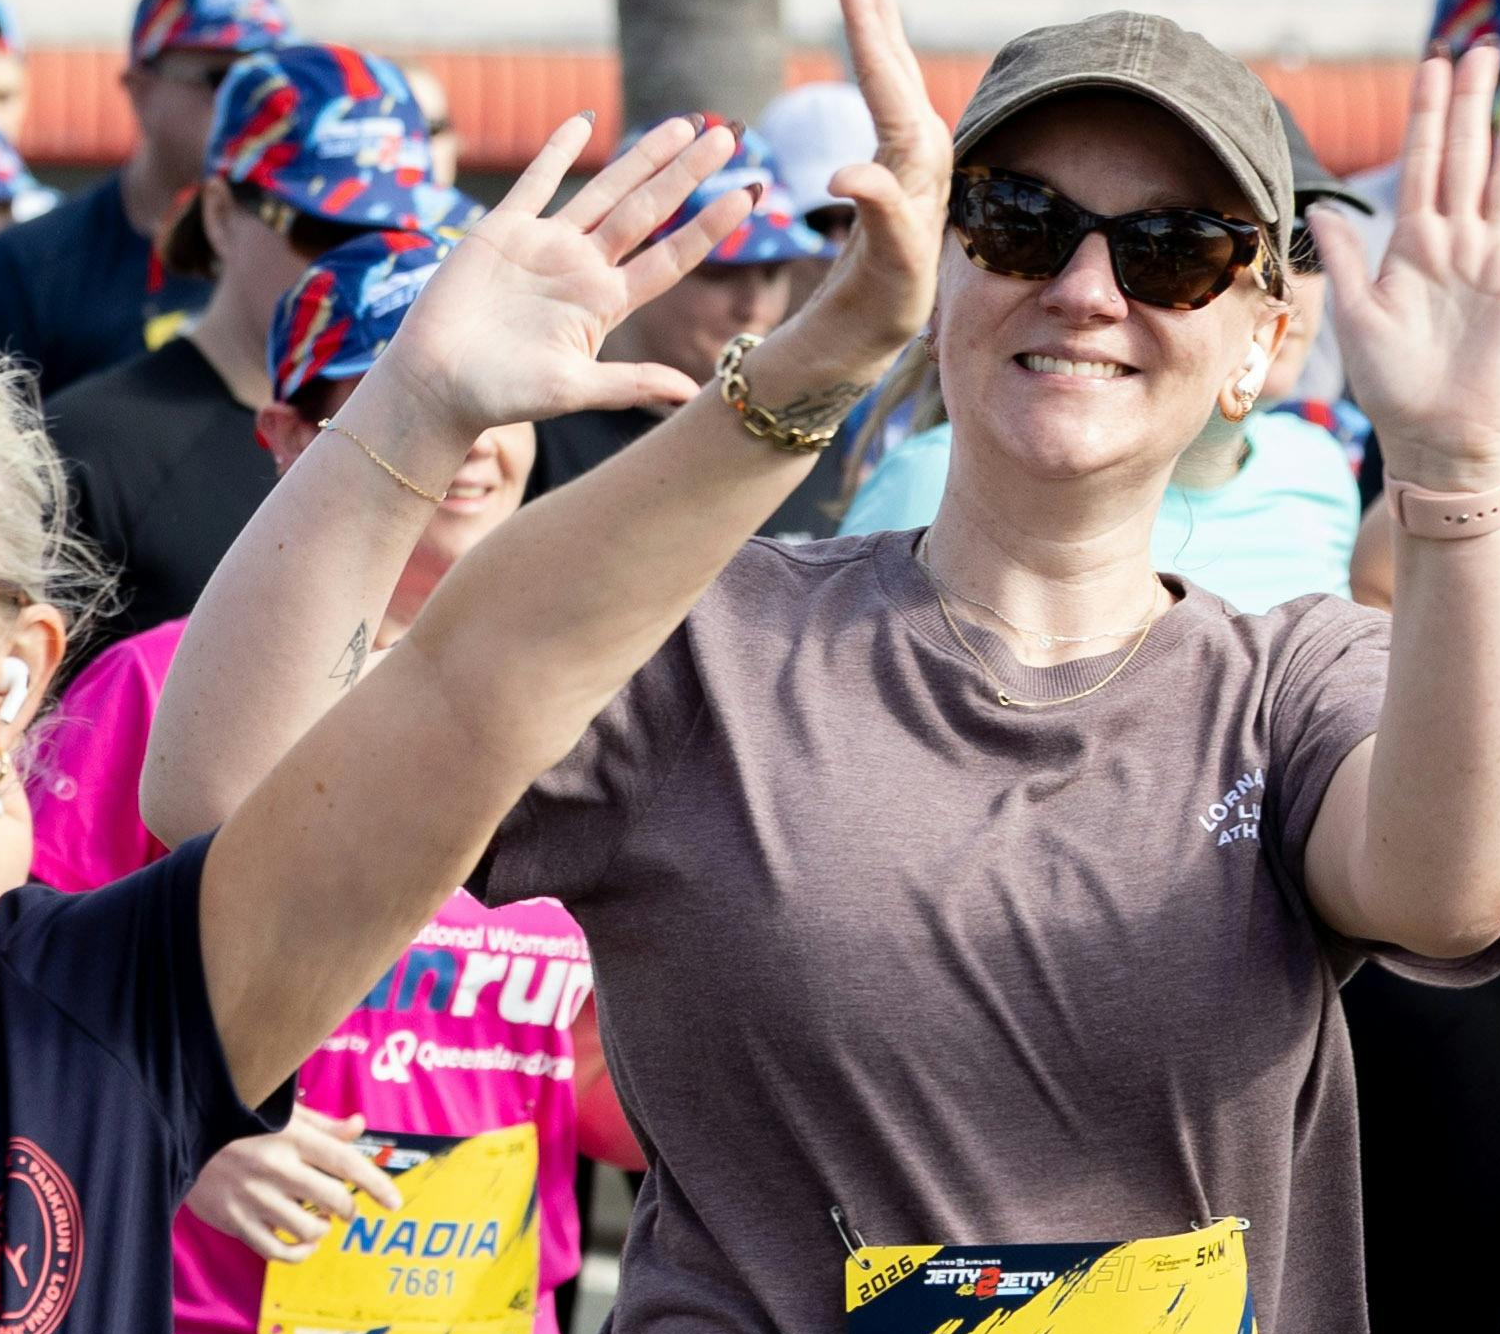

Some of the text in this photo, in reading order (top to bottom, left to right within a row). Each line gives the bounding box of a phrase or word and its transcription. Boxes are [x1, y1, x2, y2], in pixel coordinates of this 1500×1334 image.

[1198, 768, 1265, 833] LORNA
[341, 1217, 501, 1259] NADIA
[1195, 1240, 1225, 1267] 5KM
[387, 1267, 456, 1297] 7681
[857, 1254, 915, 1303] 2026
